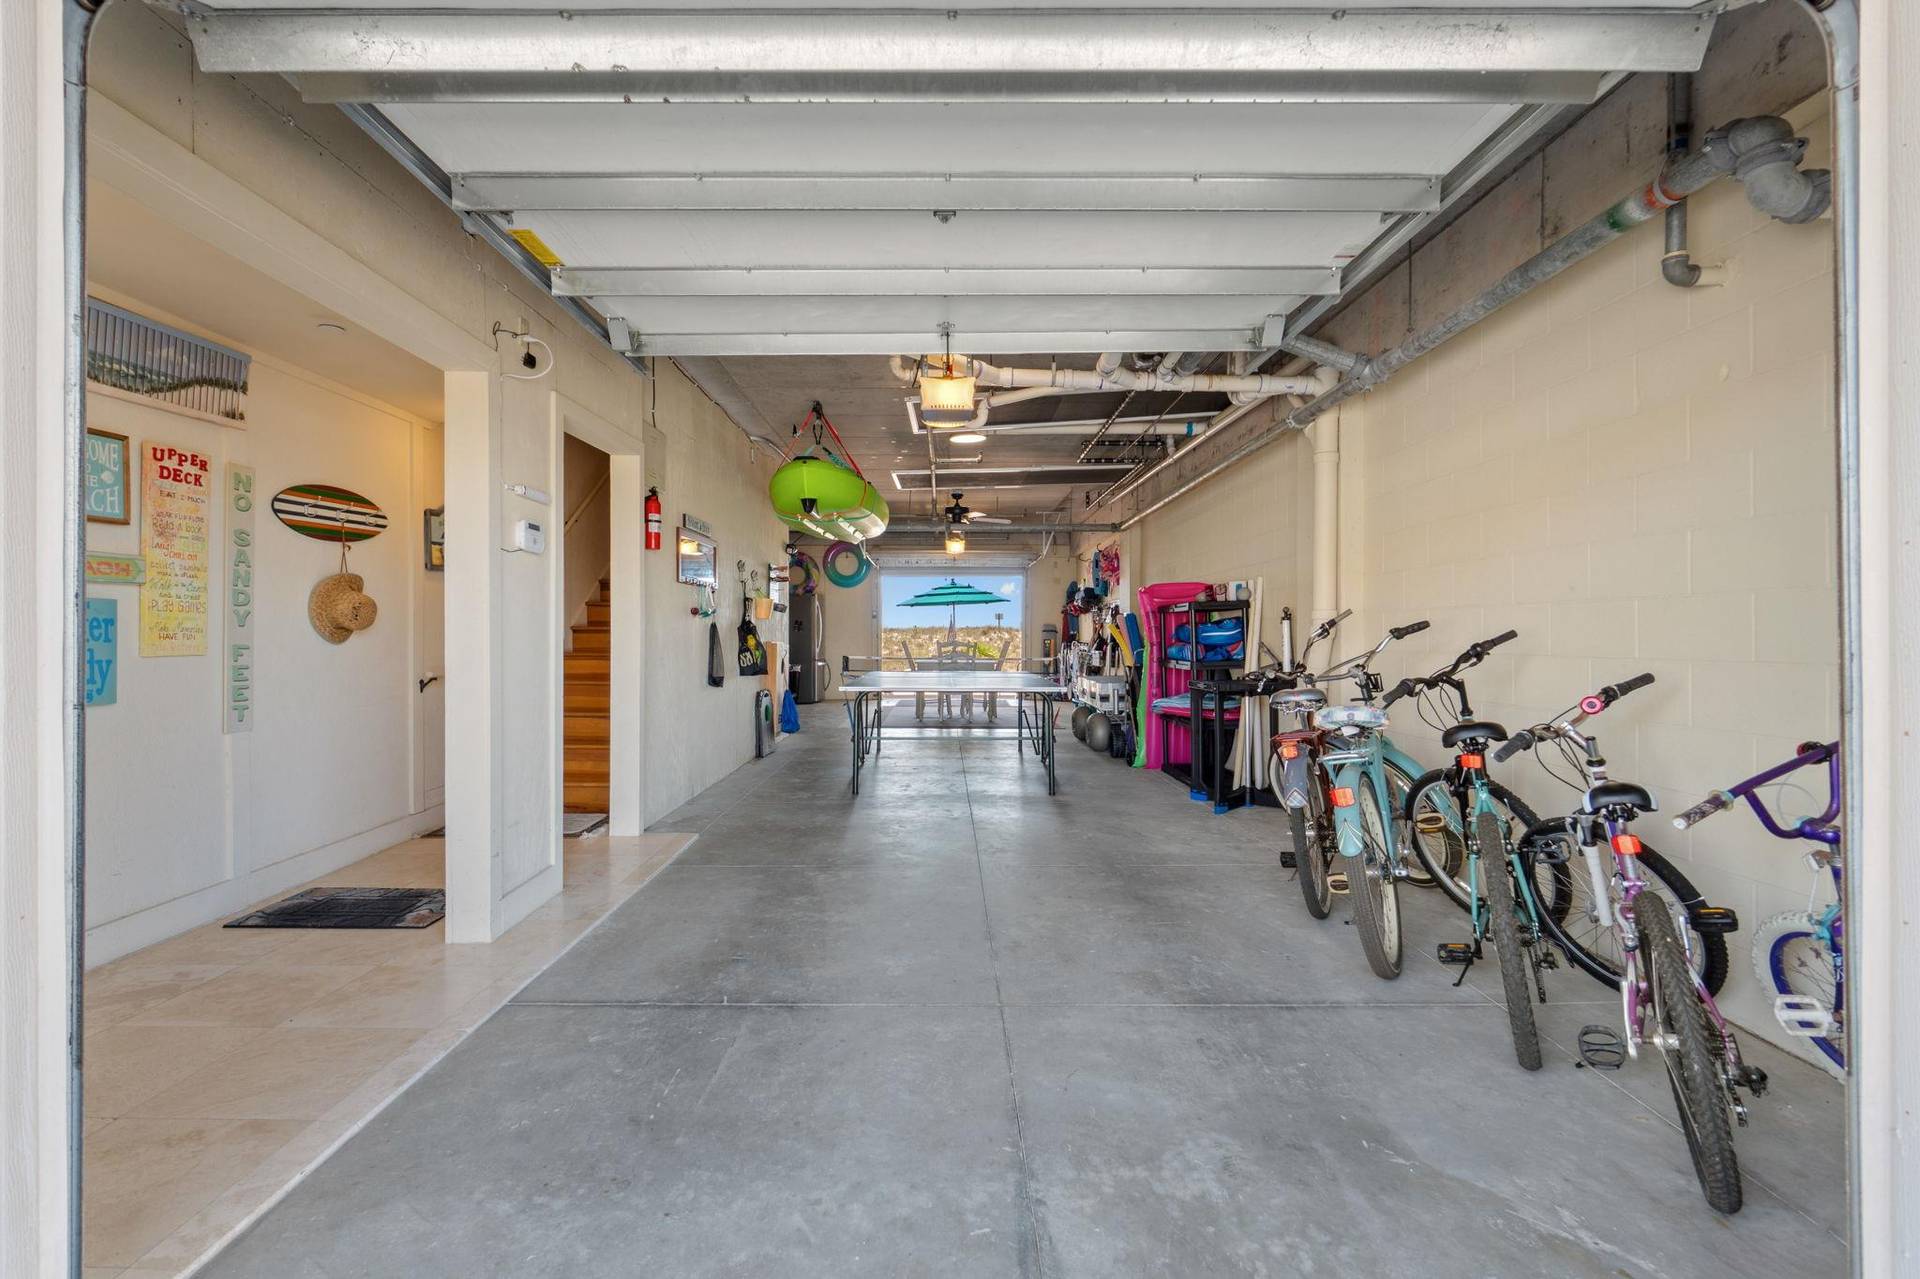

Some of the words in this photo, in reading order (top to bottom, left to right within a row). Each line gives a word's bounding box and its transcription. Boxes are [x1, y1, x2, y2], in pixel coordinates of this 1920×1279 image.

[152, 446, 209, 472] UPPER
[159, 465, 203, 487] DECK
[233, 472, 252, 512] NO
[232, 528, 252, 627] SANDY
[86, 616, 115, 643] er
[158, 632, 178, 641] HAVE
[231, 644, 250, 722] FEET
